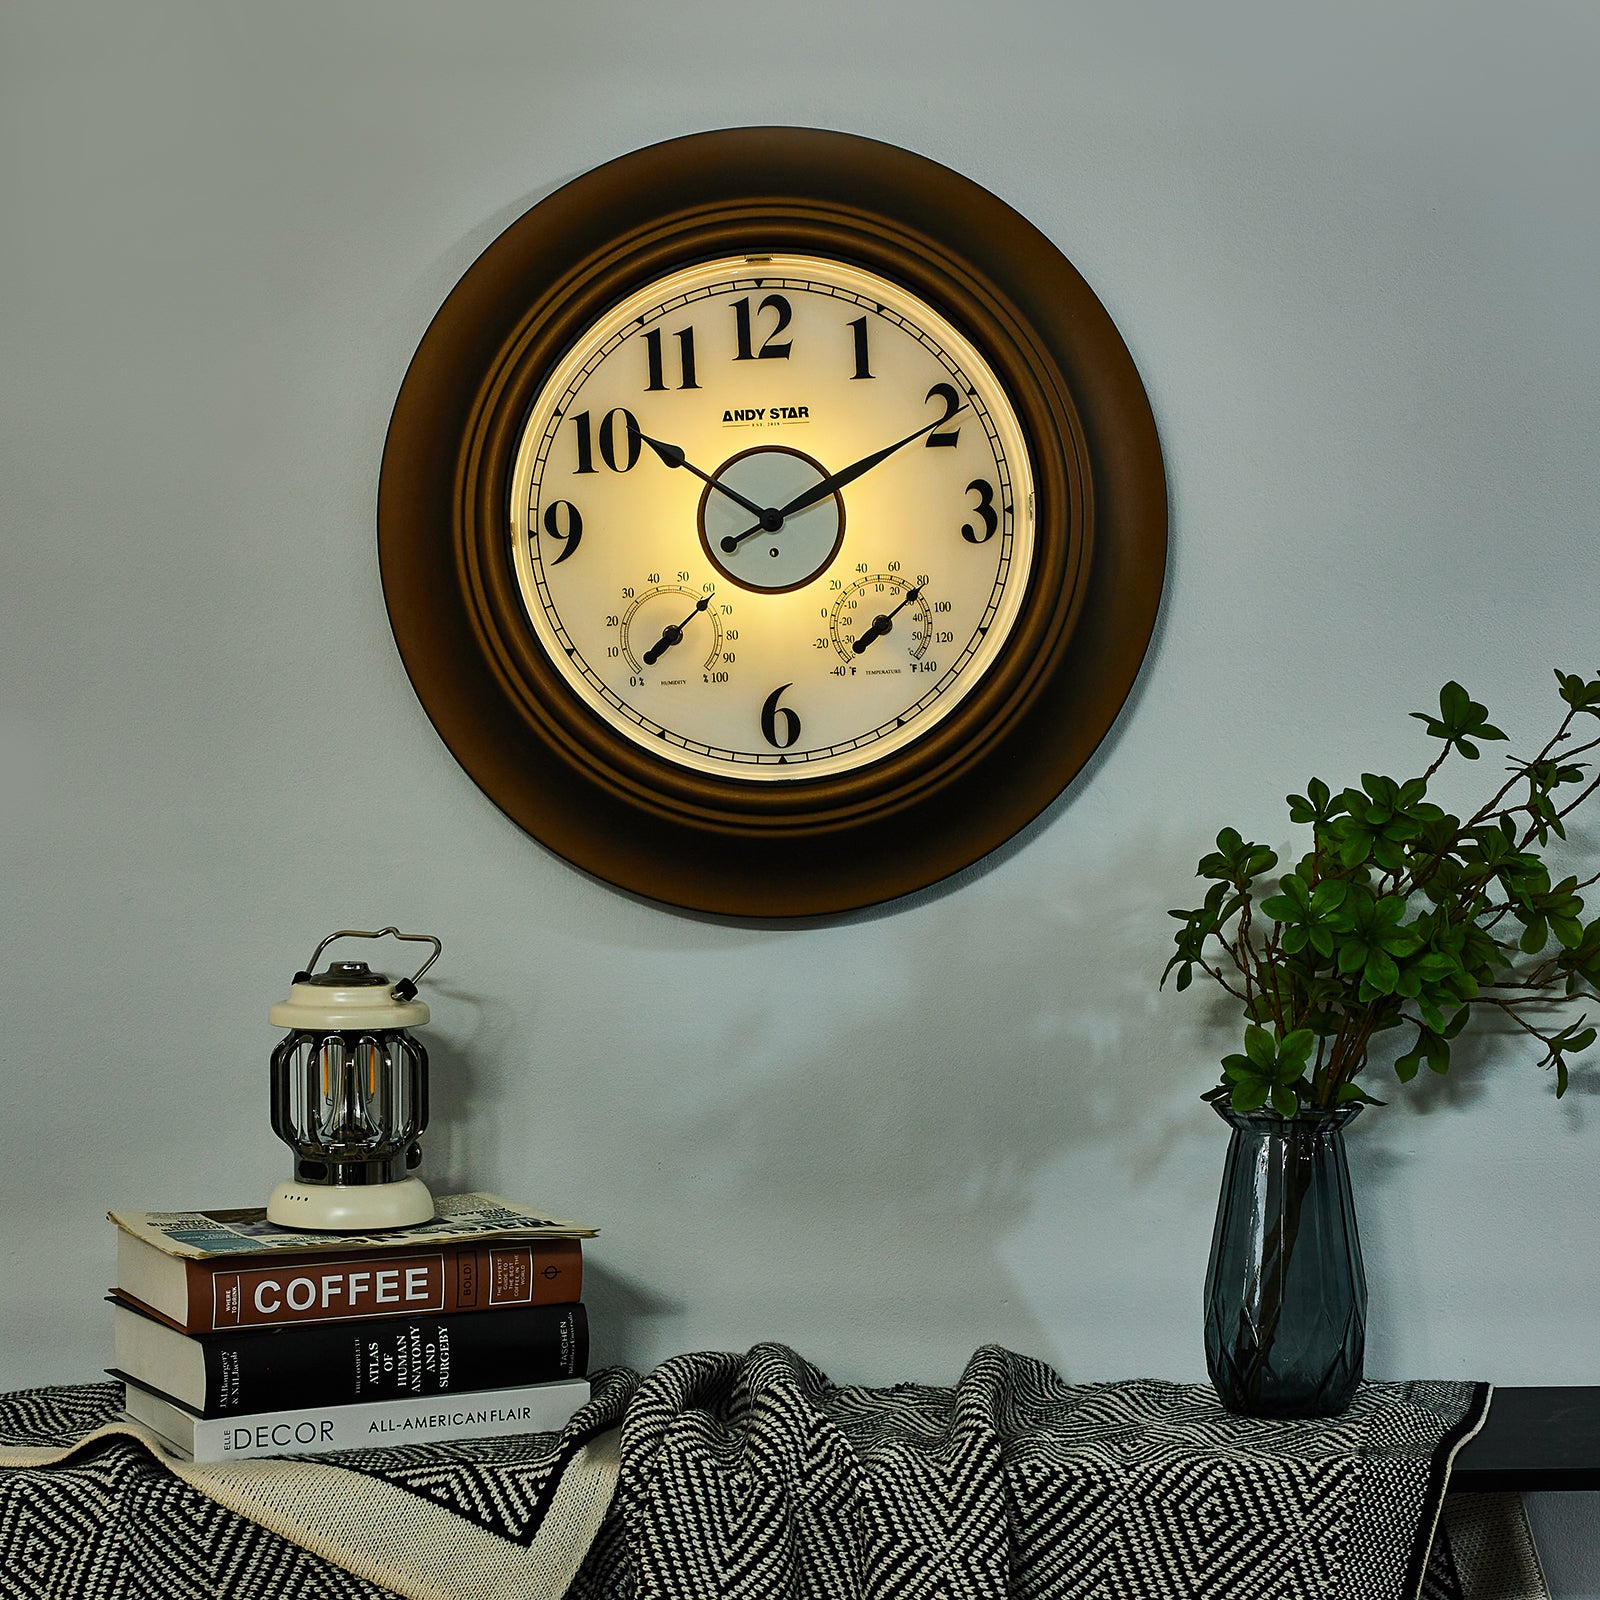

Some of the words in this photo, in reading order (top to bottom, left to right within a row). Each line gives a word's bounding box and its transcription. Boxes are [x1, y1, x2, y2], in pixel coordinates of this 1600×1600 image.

[728, 294, 794, 361] 12
[846, 315, 876, 380] 1
[640, 325, 703, 392] 11
[722, 409, 766, 422] ANDY
[769, 406, 809, 419] STAR
[924, 382, 961, 448] 2
[568, 407, 643, 475] 10
[961, 479, 998, 544] 3
[544, 500, 583, 566] 9
[855, 563, 868, 573] 40
[888, 561, 900, 572] 60
[647, 573, 660, 584] 40
[677, 571, 689, 582] 50
[916, 575, 929, 586] 80
[702, 583, 715, 593] 60
[829, 580, 842, 590] 20
[874, 583, 885, 592] 10
[622, 587, 634, 599] 30
[859, 588, 865, 597] 0
[889, 586, 900, 596] 20
[720, 605, 733, 615] 70
[843, 600, 857, 609] -10
[934, 601, 952, 613] 100
[820, 608, 828, 618] 0
[912, 613, 923, 621] 40
[606, 616, 619, 627] 20
[838, 616, 852, 626] -20
[726, 630, 739, 640] 80
[841, 635, 855, 645] -30
[911, 631, 922, 641] 50
[936, 632, 953, 643] 120
[812, 638, 829, 649] -20
[607, 647, 619, 657] 10
[723, 653, 735, 663] 90
[829, 665, 846, 676] -40
[919, 661, 937, 672] 140
[711, 672, 729, 683] 100
[761, 683, 801, 749] 6
[463, 1263, 472, 1296] BOLD!
[254, 1267, 429, 1314] COFFEE
[231, 1305, 238, 1314] TO
[560, 1321, 569, 1366] TASCHEN
[368, 1342, 379, 1385] ATLAS
[383, 1353, 393, 1372] OF
[396, 1335, 408, 1387] HUMAN
[409, 1325, 421, 1393] ANATOMY
[426, 1343, 436, 1373] AND
[223, 1430, 231, 1451] ELLE
[234, 1420, 334, 1450] DECOR
[368, 1411, 487, 1433] ALL-AMERICAN
[490, 1407, 531, 1422] FLAIR
